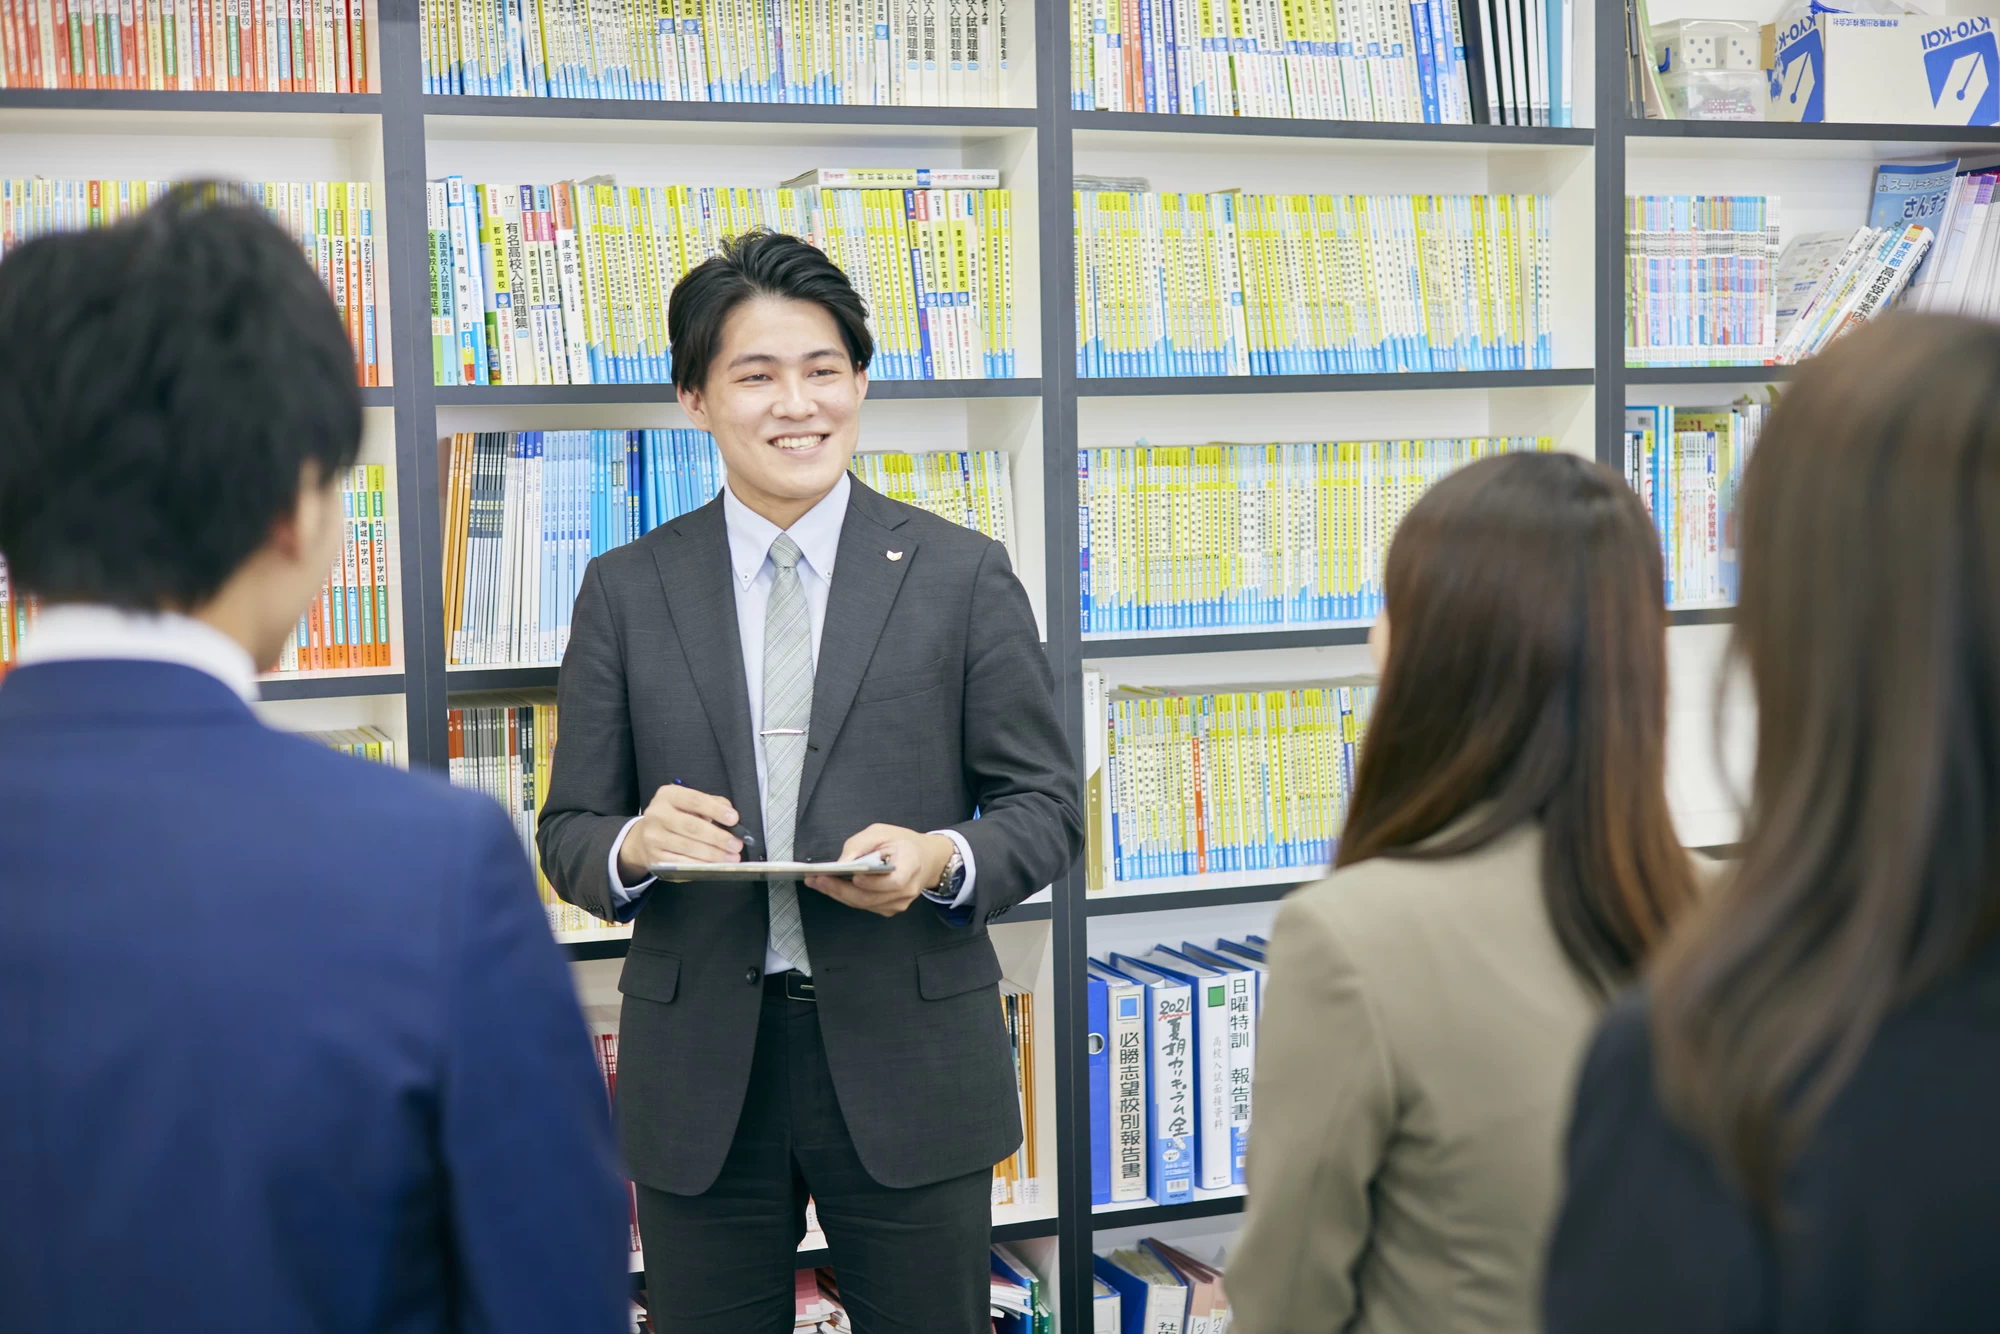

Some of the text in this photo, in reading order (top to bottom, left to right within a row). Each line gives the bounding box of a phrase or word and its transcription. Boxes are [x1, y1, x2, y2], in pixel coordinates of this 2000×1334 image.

[1832, 17, 1899, 27] 教育開発出版株式会社
[504, 195, 515, 205] 17
[335, 239, 345, 303] 女子学院中学校
[439, 232, 451, 316] 全国高校入試問題正解
[494, 226, 506, 289] 都立国立高校
[505, 222, 529, 330] 有名高校入試問題集
[528, 250, 541, 303] 東京都立高校
[544, 250, 557, 302] 都立立川高校
[562, 239, 575, 275] 東京都
[921, 230, 935, 289] 東京都立高校
[937, 230, 949, 289] 東京都立高校
[956, 229, 967, 289] 東京都立高校
[1888, 241, 1914, 268] 東京都
[1851, 265, 1898, 324] 高校受験案内
[443, 319, 451, 334] 社会
[359, 520, 369, 566] 海城中学校
[375, 520, 385, 583] 共立女子中学校
[1159, 995, 1190, 1016] 2021
[1229, 978, 1251, 1121] 日曜特訓 報告書
[1119, 1032, 1141, 1179] 必勝志望校別報告書
[1212, 1036, 1224, 1131] 高校入試面接資料
[1158, 1321, 1178, 1334] 社
